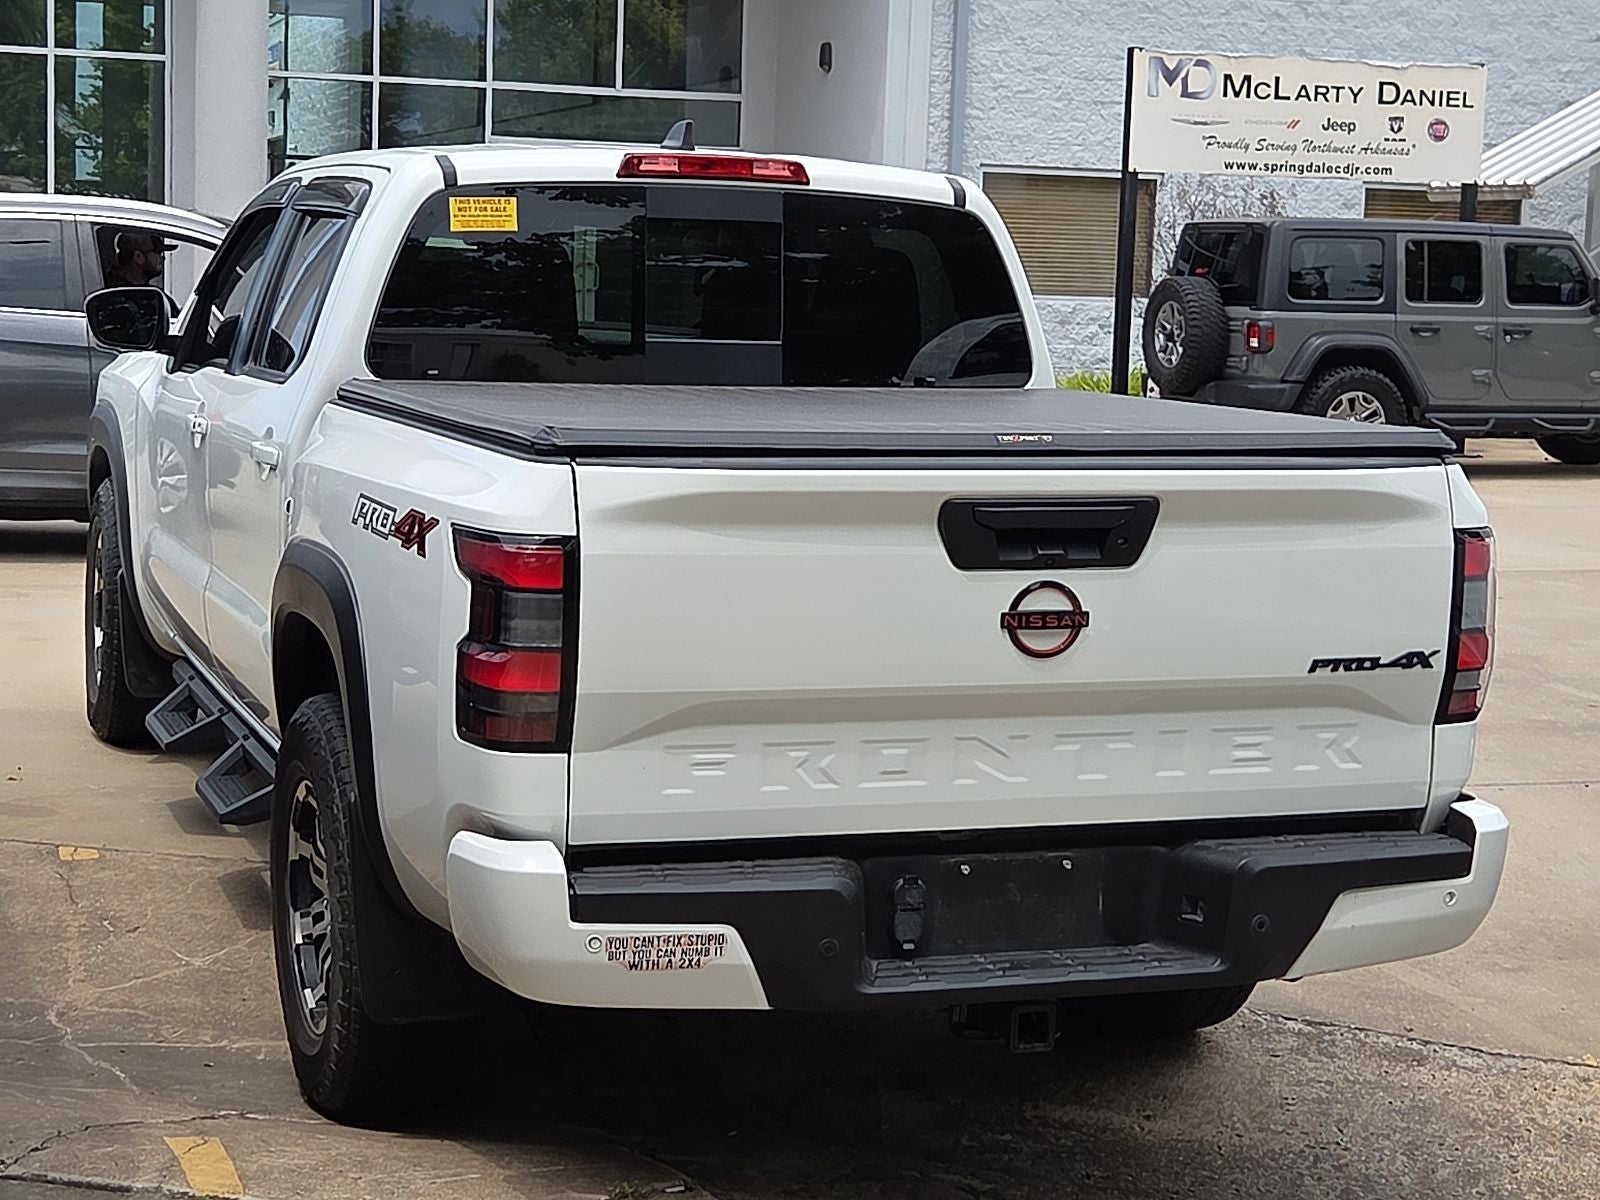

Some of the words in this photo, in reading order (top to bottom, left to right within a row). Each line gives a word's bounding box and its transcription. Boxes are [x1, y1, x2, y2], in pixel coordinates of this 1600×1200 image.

[1377, 81, 1474, 108] DANIEL
[1321, 117, 1357, 134] Jeep
[1254, 138, 1297, 156] Serving
[1223, 160, 1393, 177] www.springdalecdjr.com
[1004, 615, 1088, 627] NISSAN
[661, 722, 1363, 795] FRONTIER
[607, 937, 629, 950] YOU
[665, 934, 683, 948] FIX
[687, 933, 725, 947] STUPID
[607, 950, 627, 961] BUT
[632, 949, 652, 961] YOU
[656, 947, 677, 959] CAN
[680, 946, 711, 958] NUMB
[714, 946, 724, 957] IT
[628, 958, 660, 971] WITH
[664, 958, 673, 970] A
[678, 956, 702, 969] 2X4
